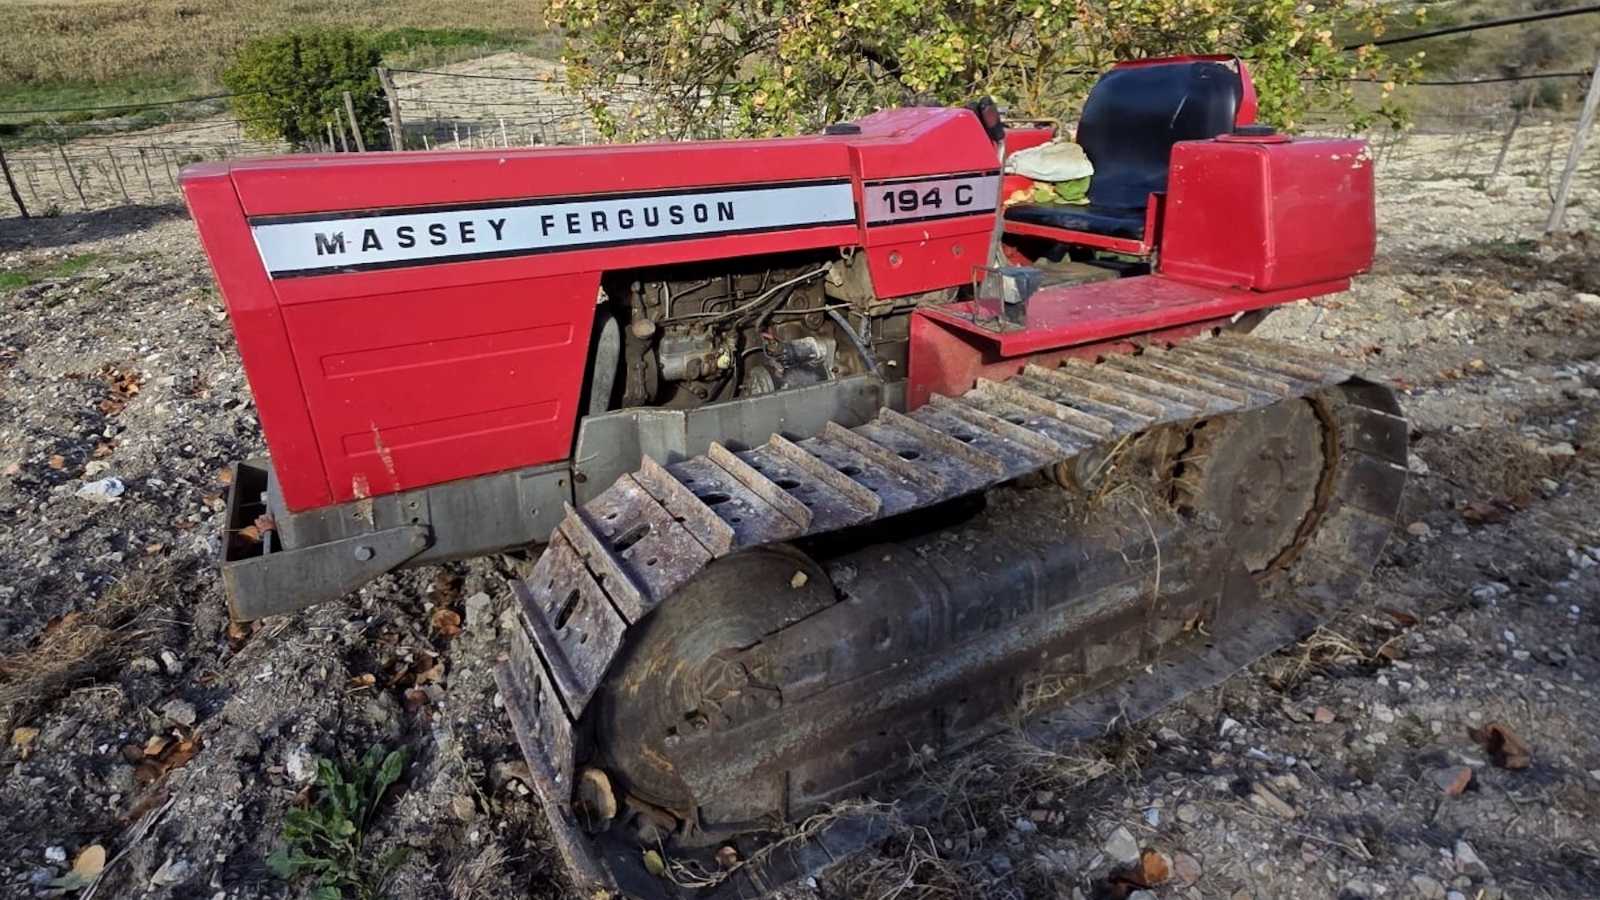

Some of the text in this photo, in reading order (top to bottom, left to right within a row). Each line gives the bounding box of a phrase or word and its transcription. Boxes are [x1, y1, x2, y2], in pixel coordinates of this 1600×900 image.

[882, 184, 974, 213] 194 C
[315, 201, 735, 255] MASSEY FERGUSON
